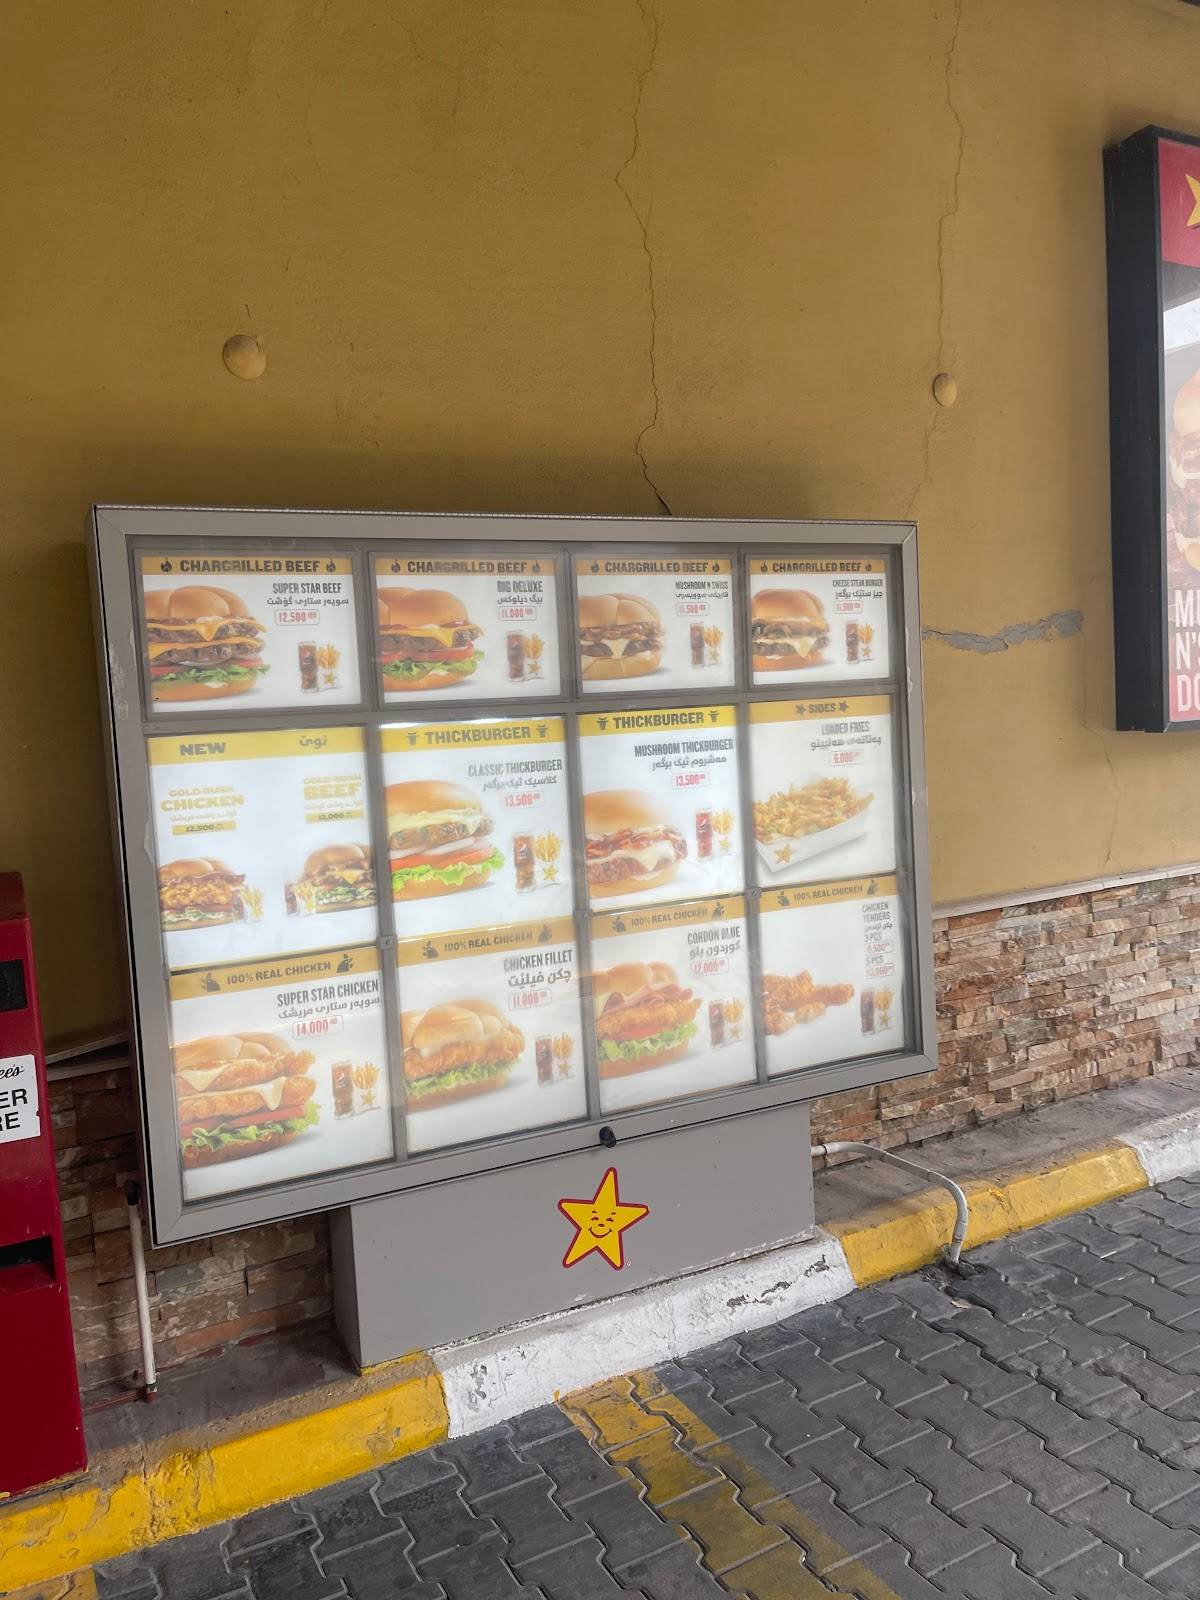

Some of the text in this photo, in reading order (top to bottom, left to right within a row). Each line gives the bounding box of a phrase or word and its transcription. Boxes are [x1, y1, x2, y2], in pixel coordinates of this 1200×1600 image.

[179, 559, 321, 573] CHARGRILLED BEEF
[407, 561, 527, 573] CHARGRILLED BEEF
[604, 561, 708, 573] CHARGRILLED BEEF
[772, 562, 862, 573] CHARGRILLED BEEF
[272, 582, 342, 594] SUPER STAR BEEF
[496, 580, 543, 593] BIG DELUXE
[675, 581, 706, 590] MUSHROOM
[808, 702, 837, 714] SIDES
[613, 711, 705, 729] THICKBURGER
[849, 720, 870, 733] FRIES
[424, 726, 531, 745] THICKBURGER
[179, 742, 226, 756] NEW
[634, 738, 734, 758] MUSHROOM THICKBURGER
[467, 758, 563, 778] CLASSIC THICKBURGER
[304, 783, 361, 800] BEEF
[160, 795, 245, 812] CHICKEN
[812, 889, 831, 899] REAL
[831, 885, 863, 897] CHICKEN
[862, 901, 889, 913] CHICKEN
[651, 913, 672, 924] REAL
[673, 908, 708, 921] CHICKEN
[444, 931, 533, 953] 100% REAL CHICKEN
[687, 926, 741, 945] CORDON BLUE
[504, 949, 573, 972] CHICKEN FILLET
[227, 961, 331, 986] 100% REAL CHICKEN
[277, 978, 379, 1007] SUPER STAR CHICKEN
[0, 1111, 21, 1132] E
